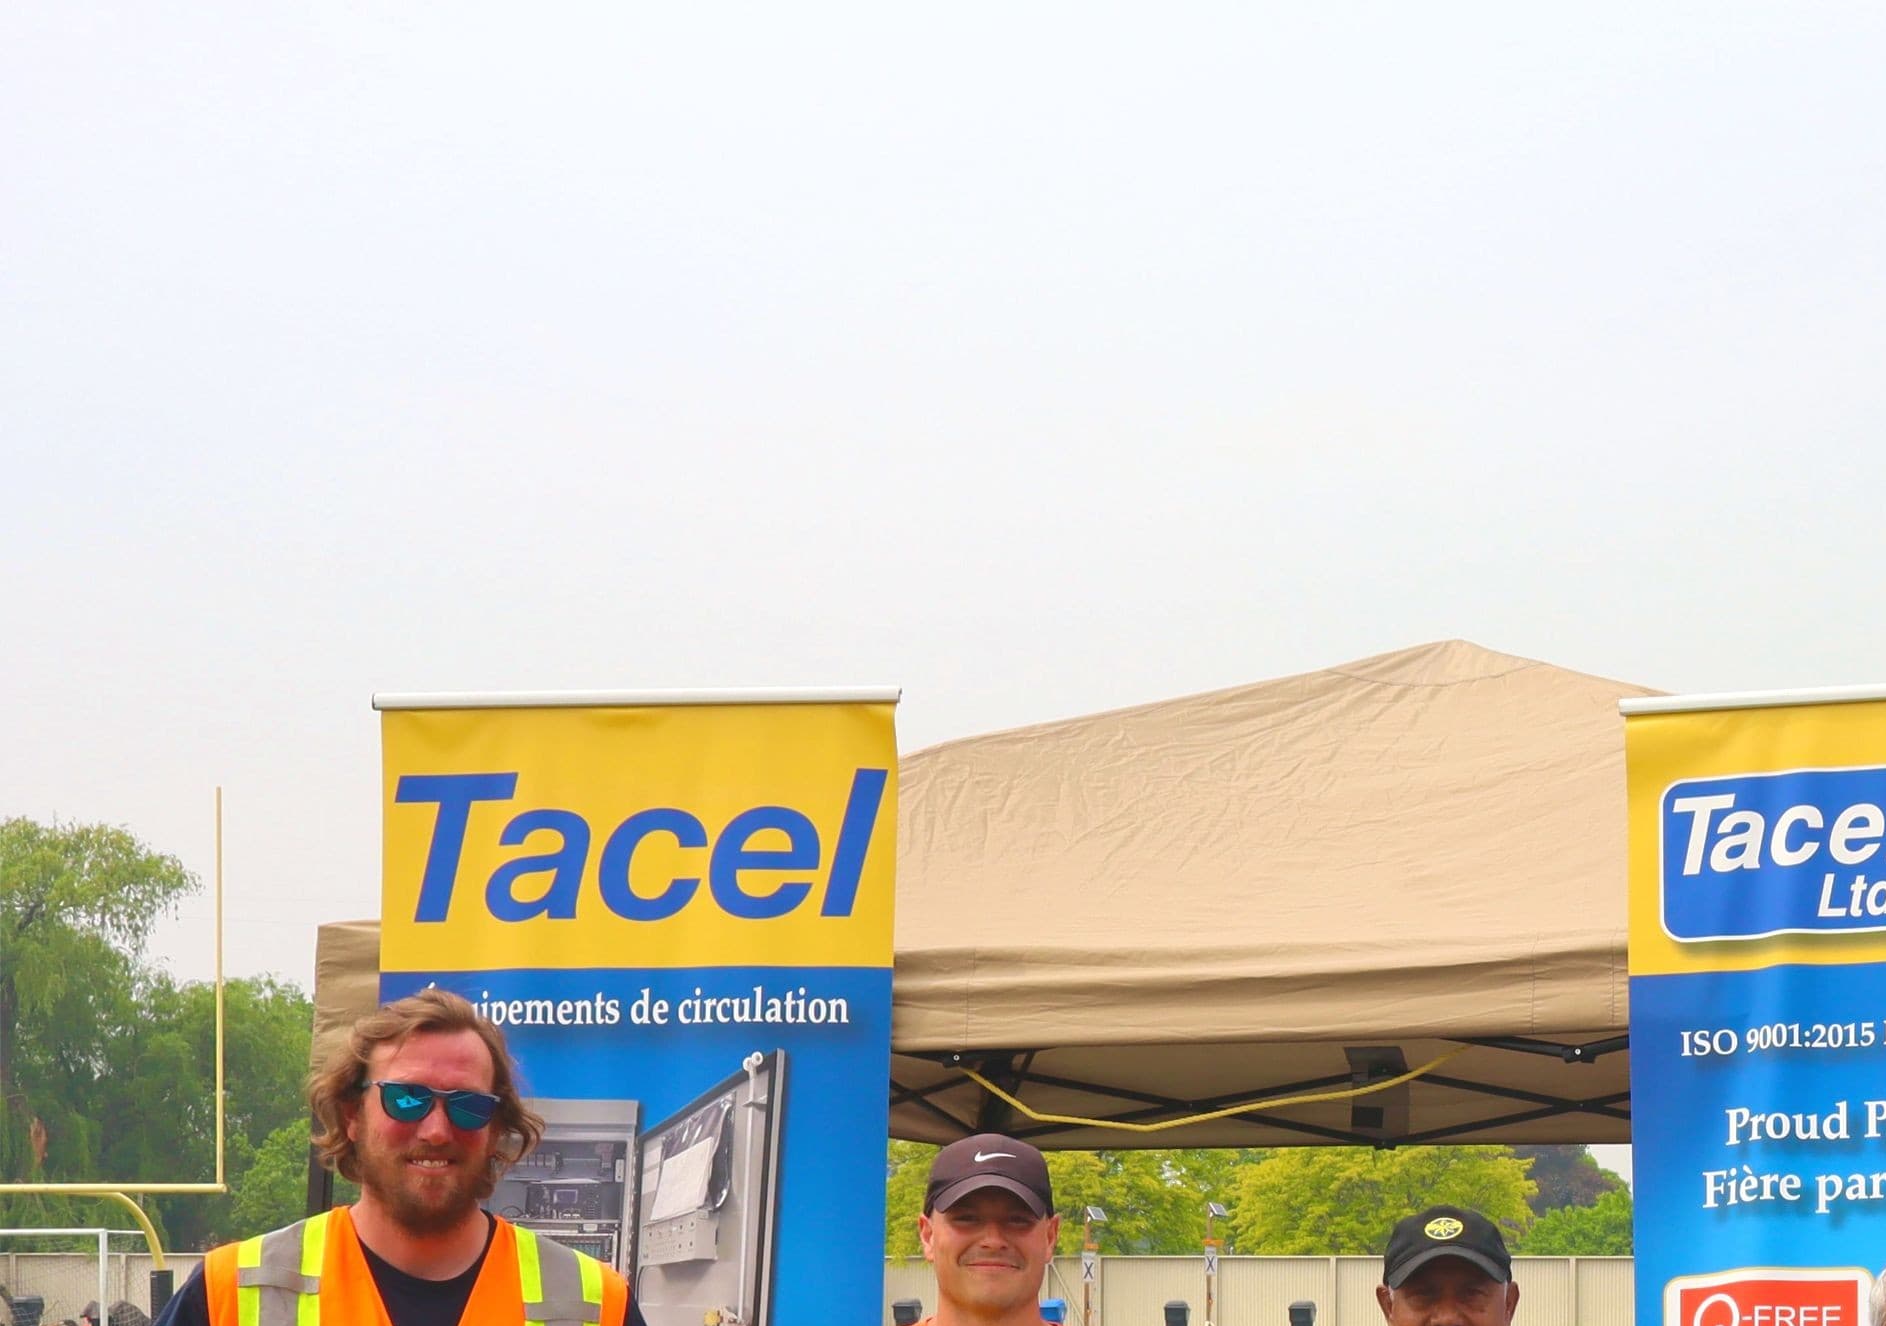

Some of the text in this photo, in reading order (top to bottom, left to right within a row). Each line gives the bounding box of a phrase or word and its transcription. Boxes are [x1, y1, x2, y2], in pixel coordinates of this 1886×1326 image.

[394, 767, 889, 923] Tacel
[630, 988, 668, 1026] de
[677, 985, 849, 1024] circulation
[1681, 1029, 1738, 1057] ISO
[1746, 1023, 1875, 1051] 9001:2015
[1725, 1100, 1850, 1146] Proud
[1702, 1164, 1802, 1209] Fière
